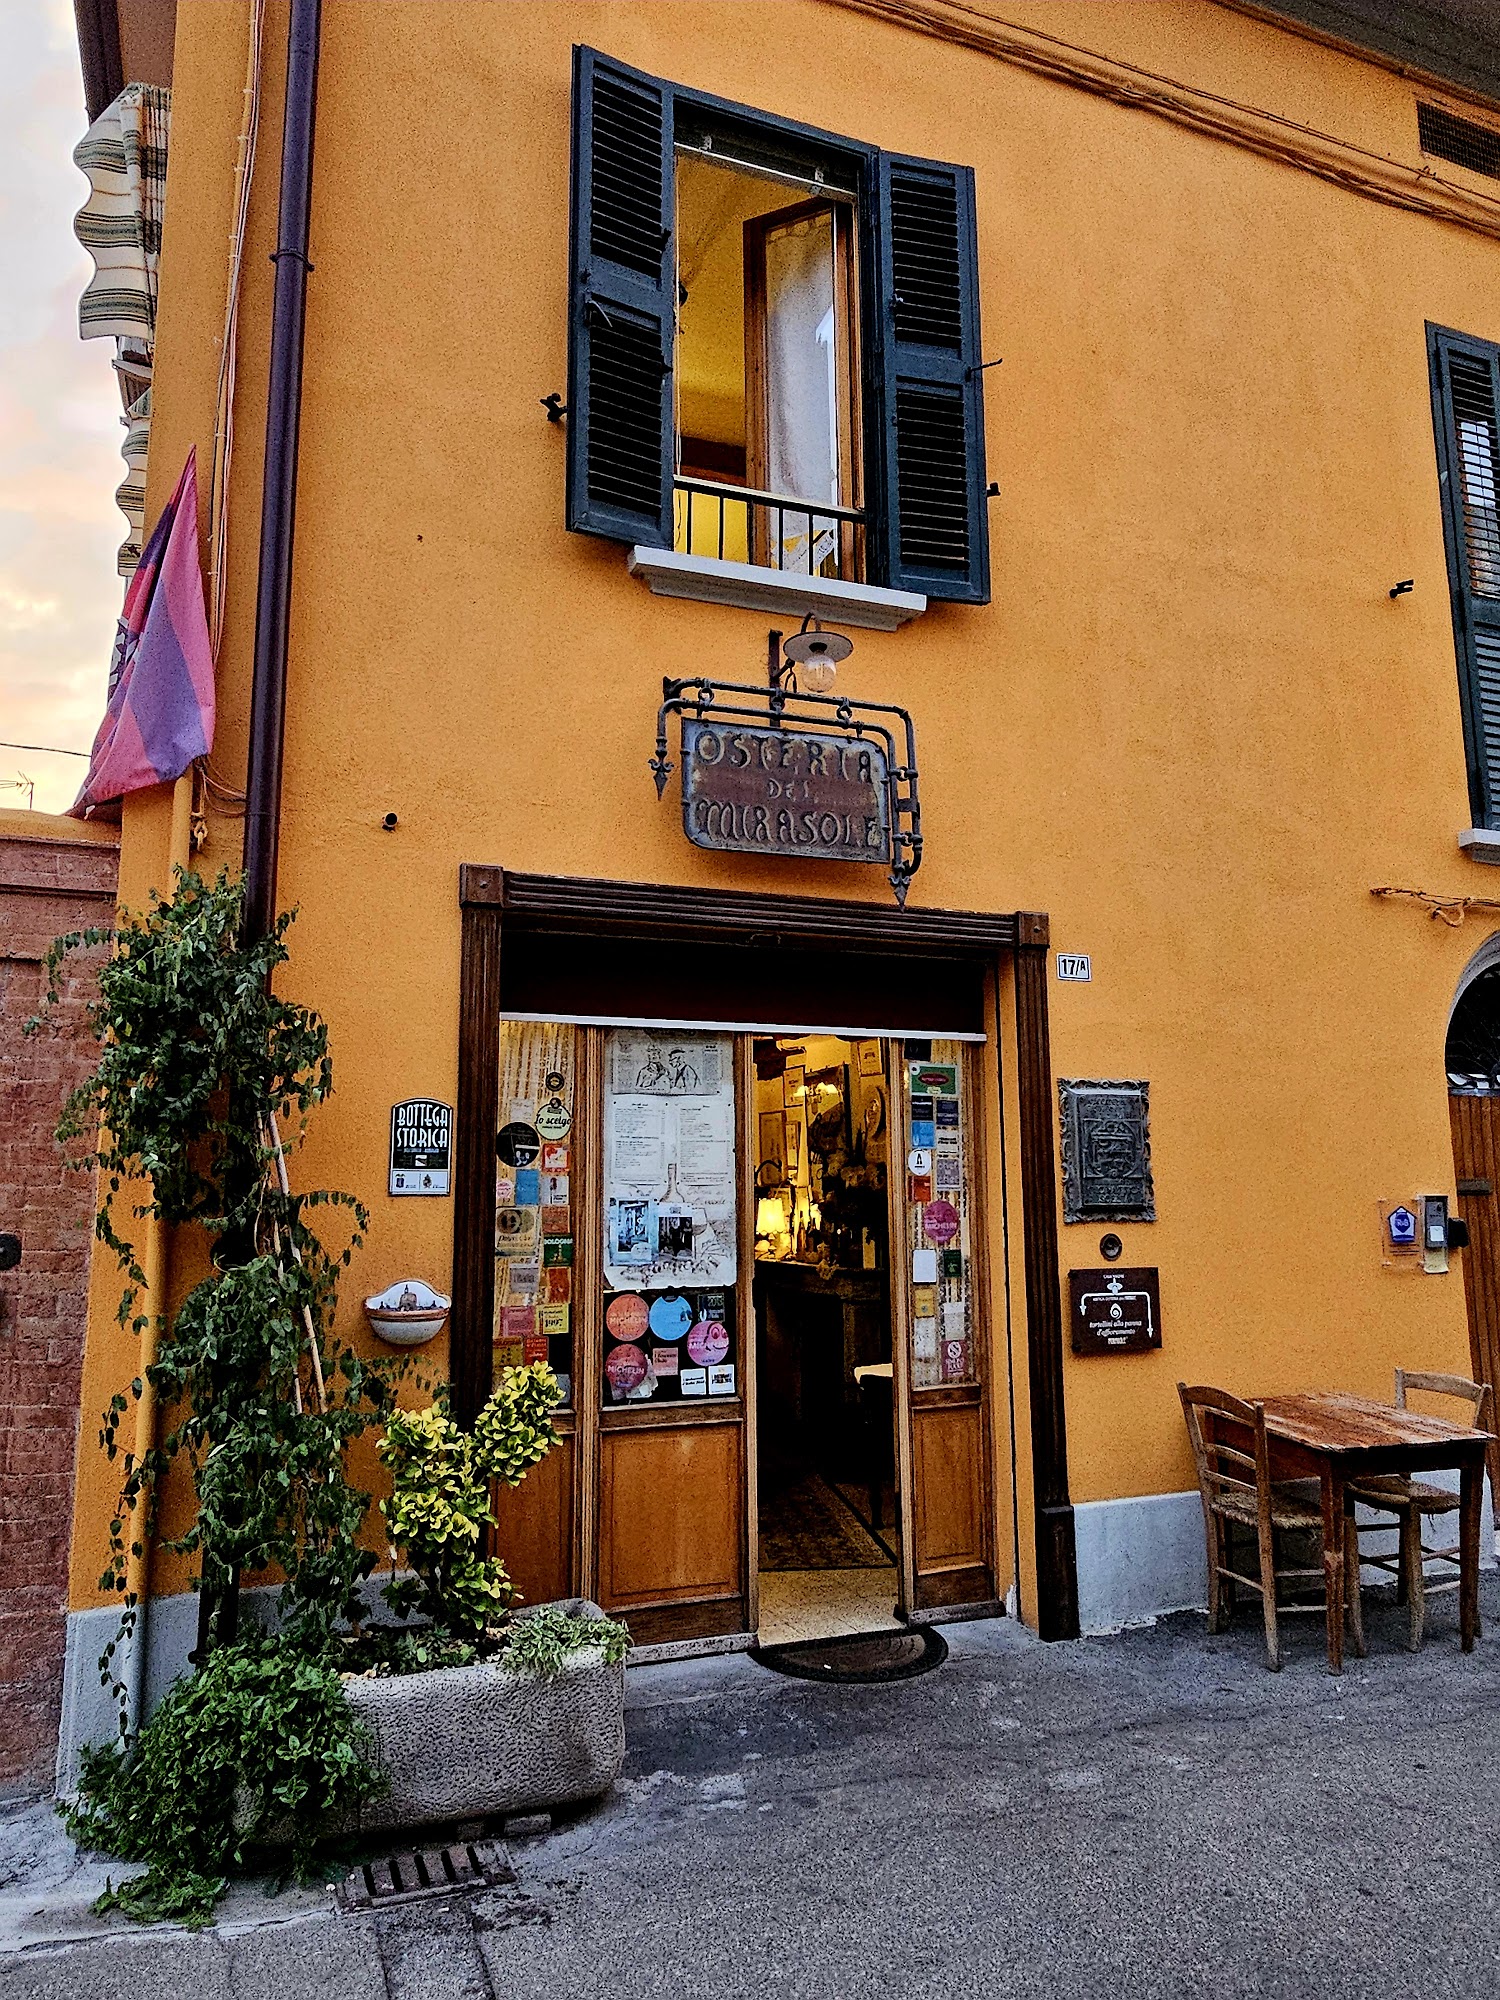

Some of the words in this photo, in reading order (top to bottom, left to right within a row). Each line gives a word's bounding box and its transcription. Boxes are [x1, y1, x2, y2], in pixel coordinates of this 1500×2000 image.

[695, 729, 872, 783] OSTERIA
[698, 798, 882, 848] MIRASOLE
[1061, 958, 1086, 976] 17/A
[396, 1103, 448, 1127] BOTTEGA
[546, 1115, 572, 1128] scelgo
[396, 1128, 448, 1148] STORICA
[607, 1365, 645, 1374] MICHELIN
